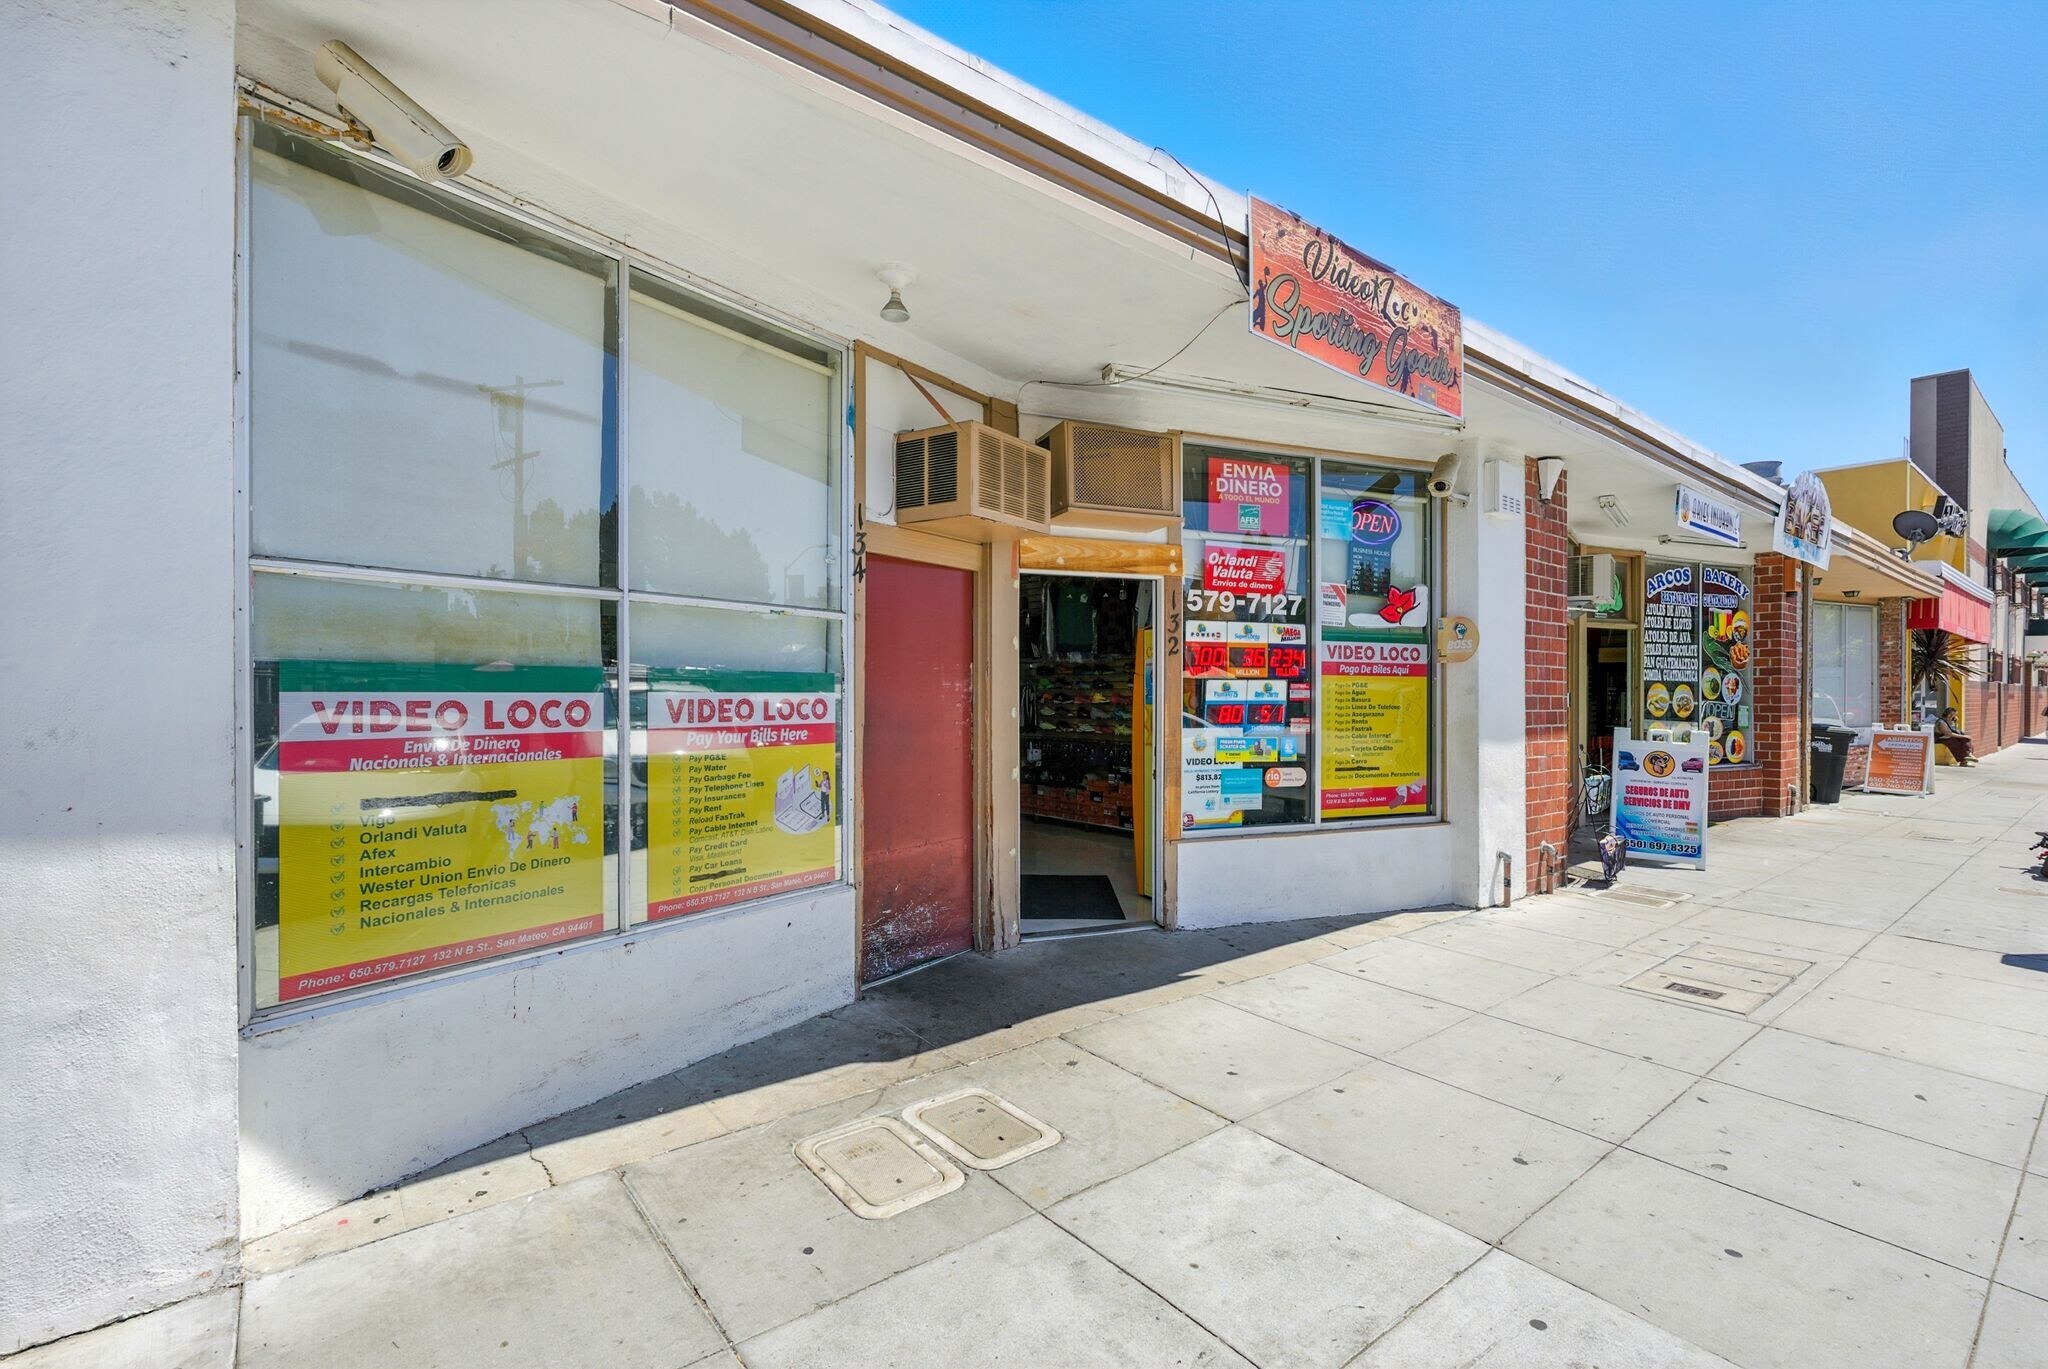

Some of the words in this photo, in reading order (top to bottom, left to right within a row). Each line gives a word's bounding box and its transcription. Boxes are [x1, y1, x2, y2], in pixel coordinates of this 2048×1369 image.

[1303, 240, 1373, 300] Video
[1266, 273, 1382, 376] Sporting
[1385, 326, 1455, 388] Goods
[1223, 463, 1276, 481] ENVIA
[1216, 478, 1282, 497] DINERO
[1352, 511, 1394, 534] OPEN
[1352, 547, 1373, 555] BUSINESS
[1209, 553, 1258, 567] Orlandi
[1212, 565, 1253, 579] Valuta
[1238, 581, 1248, 589] de
[1250, 581, 1273, 590] dinero
[1647, 567, 1691, 598] ARCOS
[1704, 567, 1750, 600] BAKERY
[1187, 590, 1302, 615] 579-7127
[1646, 604, 1666, 616] ATOLES
[1667, 605, 1674, 616] DE
[1675, 605, 1692, 617] AVENA
[1644, 617, 1664, 629] ATOLES
[1664, 618, 1672, 629] DE
[1644, 631, 1668, 643] ATOLES
[1669, 632, 1678, 643] DE
[1327, 645, 1375, 660] VIDEO
[1380, 647, 1421, 661] LOCO
[1669, 645, 1698, 656] CHOCOLATE
[1339, 665, 1359, 674] Pago
[1361, 665, 1371, 673] De
[1372, 664, 1391, 673] Biles
[1644, 656, 1656, 668] PAN
[312, 700, 468, 734] VIDEO
[484, 699, 592, 730] LOCO
[665, 698, 754, 724] VIDEO
[763, 697, 828, 721] LOCO
[687, 731, 713, 749] Pay
[717, 730, 748, 744] Your
[751, 727, 777, 743] Bills
[780, 727, 808, 741] Here
[404, 738, 448, 754] Envi
[450, 739, 470, 752] De
[474, 738, 520, 751] Dinero
[350, 754, 433, 771] Nacionals
[437, 754, 449, 766] &
[453, 749, 562, 766] Internacionales
[689, 755, 702, 764] Pay
[1186, 758, 1212, 766] VIDEO
[689, 766, 702, 774] Pay
[704, 764, 727, 772] Water
[689, 776, 702, 784] Pay
[704, 774, 735, 782] Garbage
[689, 786, 702, 794] Pay
[704, 783, 743, 792] Telephone
[1625, 785, 1658, 797] SEGUROS
[1659, 788, 1669, 798] DE
[1669, 789, 1689, 799] AUTO
[689, 797, 702, 805] Pay
[704, 793, 746, 802] Insurances
[1624, 796, 1661, 808] SERVICIOS
[1663, 800, 1672, 810] DE
[689, 807, 702, 815] Pay
[704, 805, 722, 813] Rent
[360, 815, 396, 832] Vigo
[689, 815, 714, 825] Reload
[715, 812, 745, 822] FasTrak
[360, 828, 418, 845] Orlandi
[423, 824, 467, 839] Valuta
[689, 828, 702, 836] Pay
[704, 824, 726, 832] Cable
[728, 820, 758, 829] Internet
[360, 847, 396, 861] Afex
[689, 846, 702, 854] Pay
[704, 842, 728, 851] Credit
[730, 839, 748, 847] Card
[360, 856, 452, 878] Intercambio
[689, 865, 702, 873] Pay
[704, 862, 718, 870] Car
[720, 858, 743, 867] Loans
[360, 879, 415, 896] Wester
[420, 871, 463, 887] Union
[467, 864, 506, 879] Envio
[510, 861, 527, 872] De
[530, 855, 571, 870] Dinero
[689, 884, 708, 894] Copy
[709, 878, 743, 890] Personal
[744, 869, 783, 882] Documents
[360, 892, 433, 913] Recargas
[438, 878, 516, 899] Telefonicas
[658, 902, 685, 913] Phone:
[686, 893, 731, 907] 650.579.7127
[360, 904, 445, 929] Nacionales
[451, 901, 461, 914] &
[465, 884, 565, 911] Internacionales
[298, 973, 345, 991] Phone:
[349, 955, 426, 980] 650.579.7127
[432, 949, 452, 961] 132
[454, 947, 463, 956] N
[465, 945, 474, 955] B
[496, 937, 516, 949] San
[552, 926, 567, 937] CA
[568, 920, 594, 933] 94401
